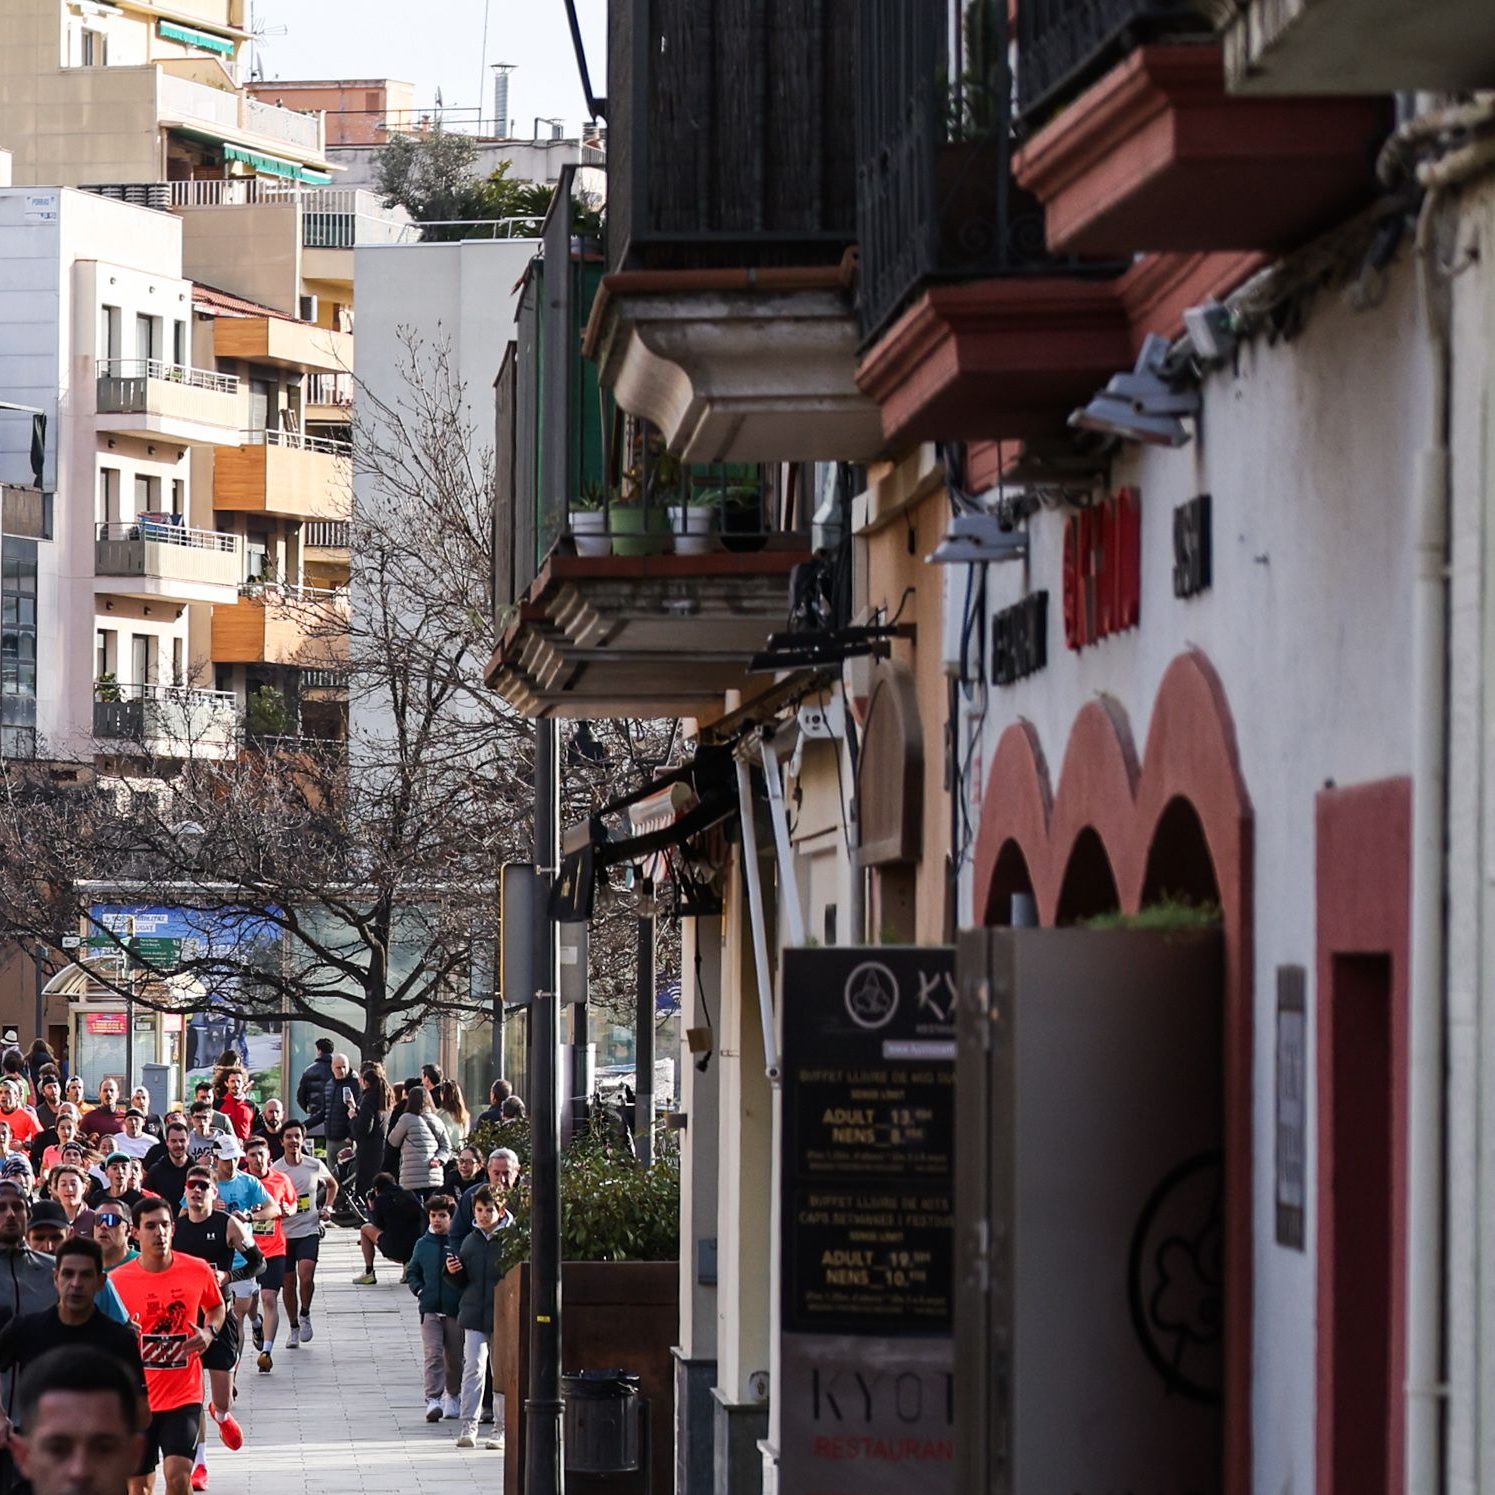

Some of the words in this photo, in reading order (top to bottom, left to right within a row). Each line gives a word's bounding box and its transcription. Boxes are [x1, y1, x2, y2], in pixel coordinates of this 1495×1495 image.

[822, 1108, 875, 1125] ADULT
[832, 1127, 875, 1144] NENS
[821, 1250, 874, 1267] ADULT
[826, 1268, 869, 1285] NENS
